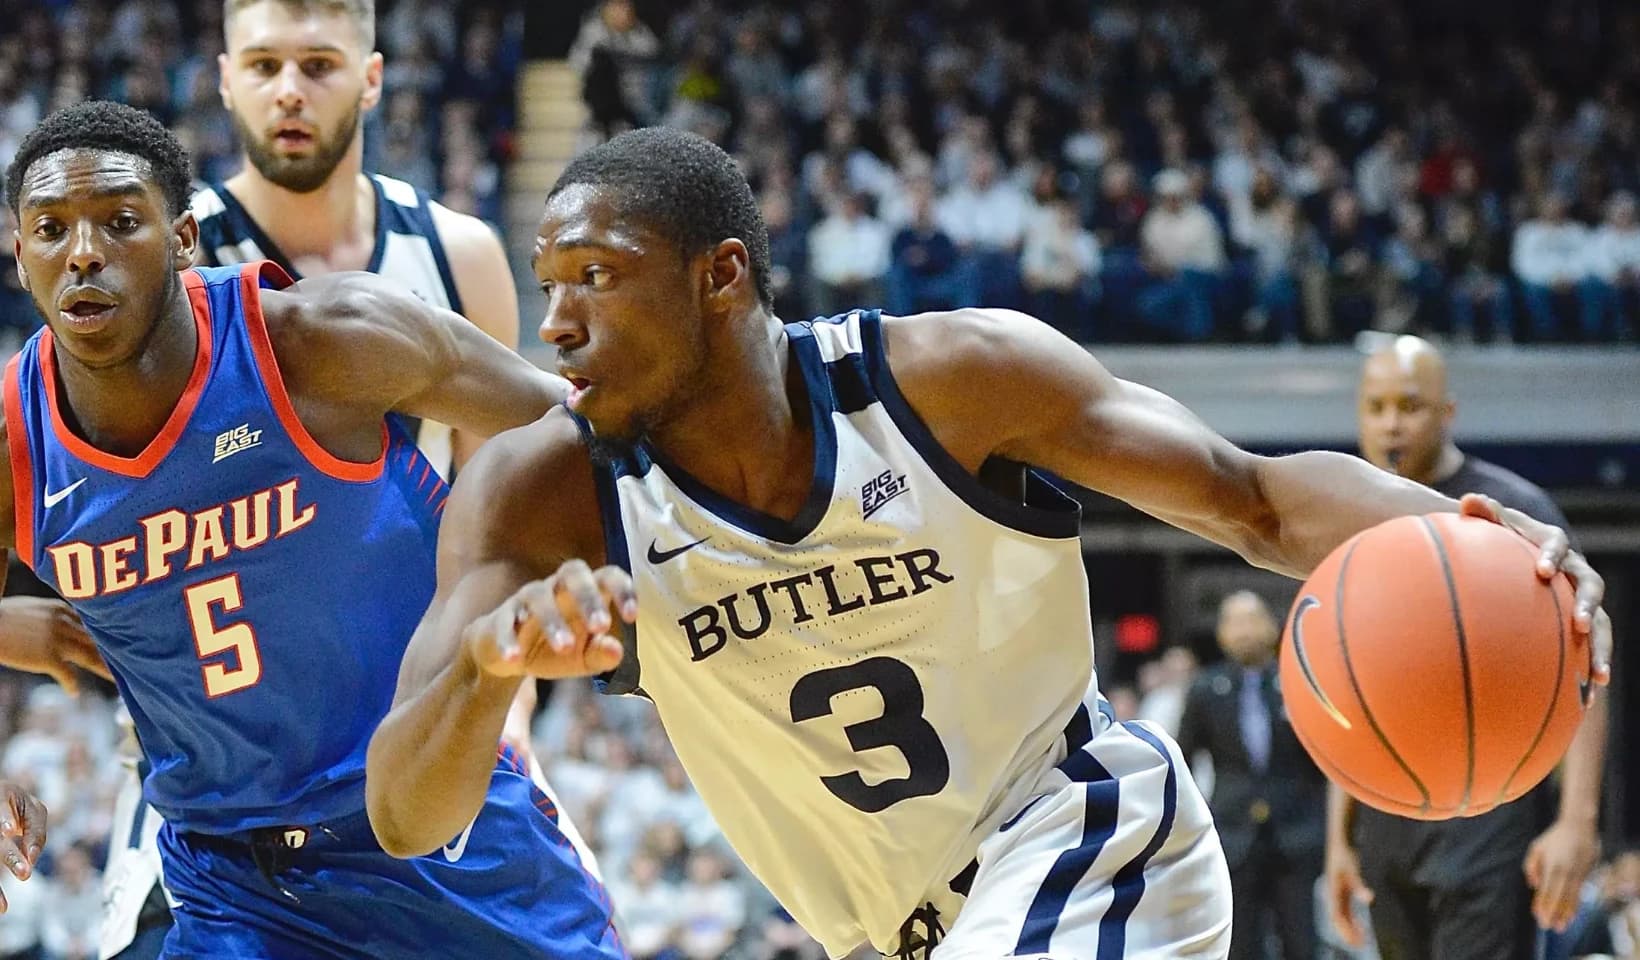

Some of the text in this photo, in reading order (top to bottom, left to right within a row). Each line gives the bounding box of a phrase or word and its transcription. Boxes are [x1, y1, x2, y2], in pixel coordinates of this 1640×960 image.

[214, 430, 263, 457] EAST
[216, 423, 249, 447] BIG
[862, 469, 892, 499] BIG
[862, 474, 907, 513] EAST
[678, 548, 954, 662] BUTLER
[184, 572, 264, 700] 5
[789, 656, 950, 813] 3
